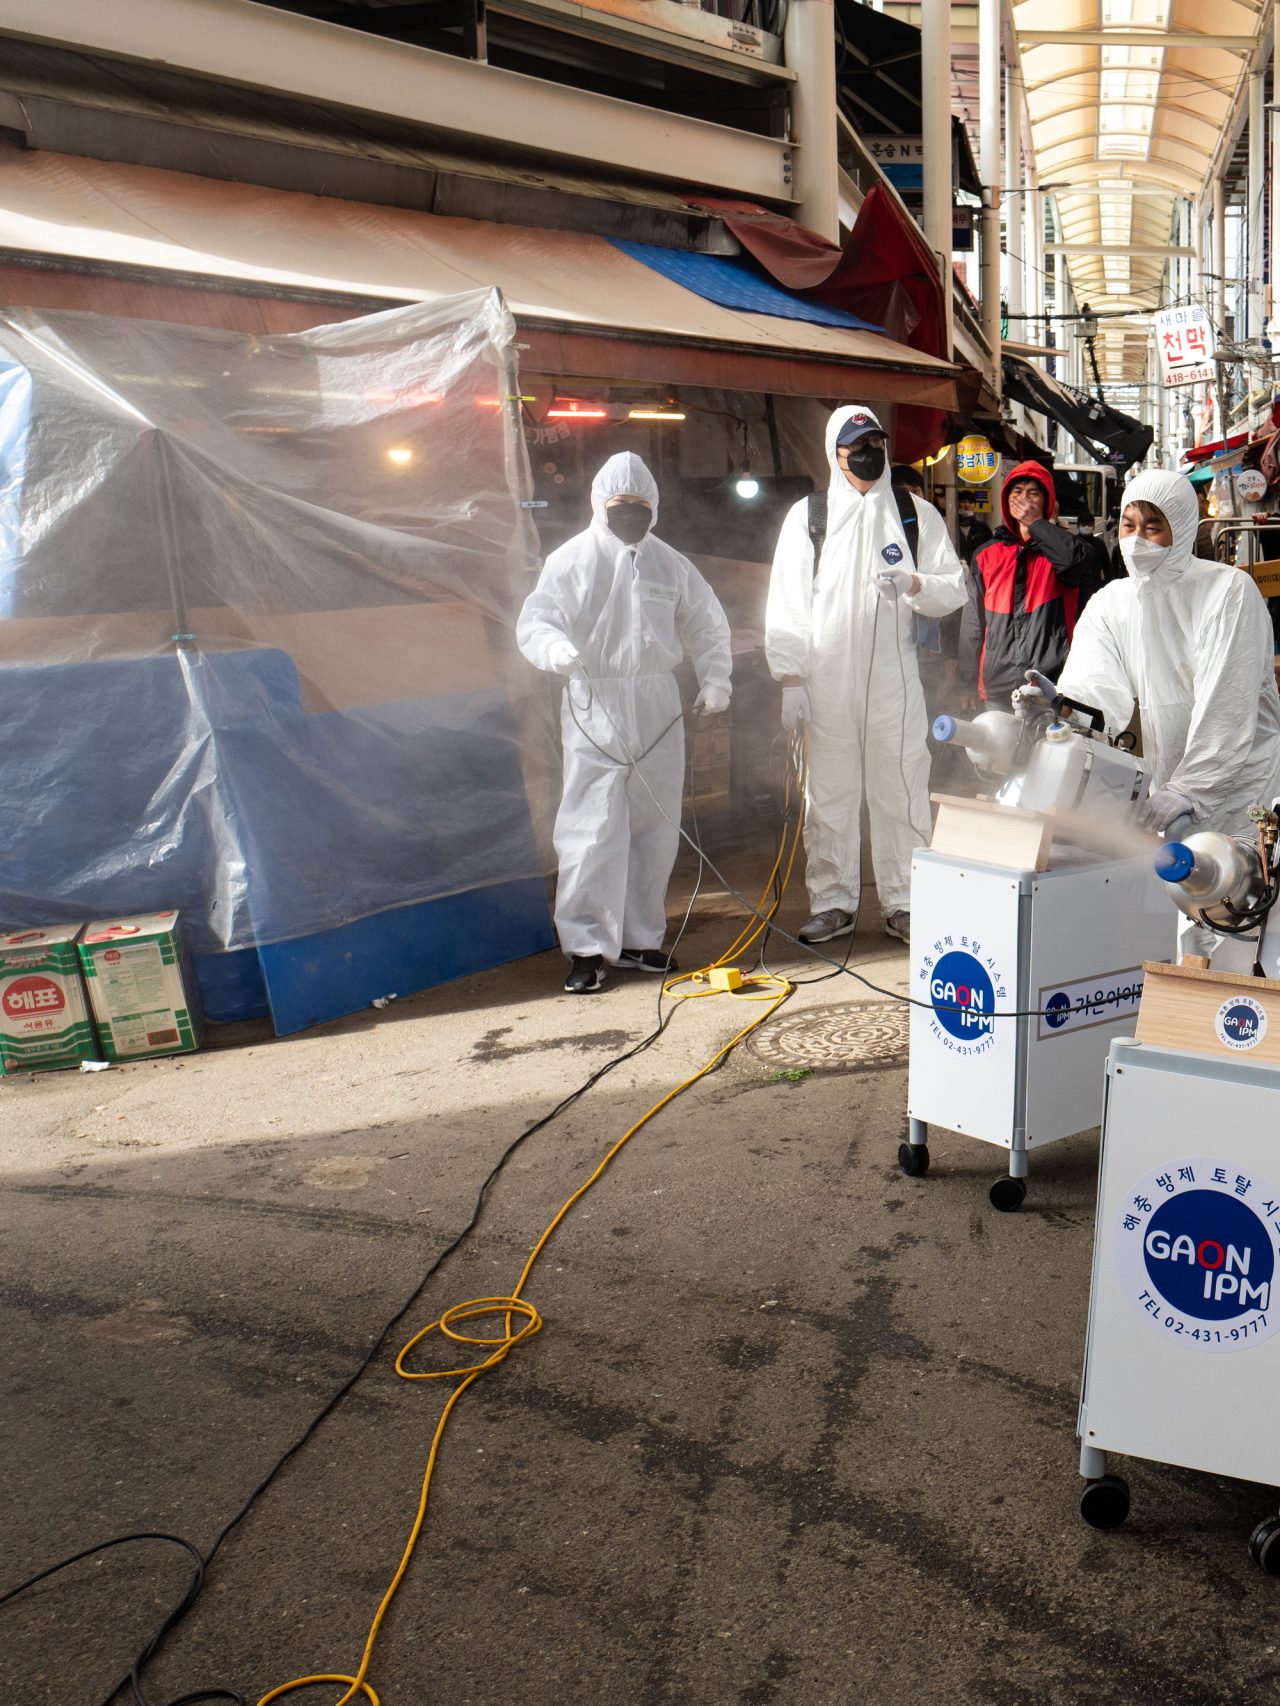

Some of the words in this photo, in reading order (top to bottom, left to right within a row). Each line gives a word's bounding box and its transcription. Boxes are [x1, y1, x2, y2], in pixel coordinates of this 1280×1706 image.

[1163, 326, 1205, 362] 천막
[919, 955, 933, 980] 해충
[933, 935, 953, 954] 방제
[961, 936, 981, 955] 토탈
[986, 957, 1007, 998] 시스템
[7, 987, 59, 1010] 해표
[931, 979, 983, 1009] GAON
[929, 1019, 942, 1039] TEL
[943, 1035, 995, 1055] 02-431-9777
[961, 1006, 994, 1034] IPM
[1224, 1016, 1253, 1028] GAON
[1239, 1026, 1258, 1036] IPM
[1122, 1195, 1153, 1232] 해충
[1155, 1165, 1196, 1193] 방제
[1210, 1167, 1252, 1197] 토탈
[1145, 1229, 1252, 1276] GAON
[1203, 1270, 1270, 1311] IPM
[1138, 1290, 1161, 1319] TEL
[1164, 1314, 1268, 1342] 02-431-9777
